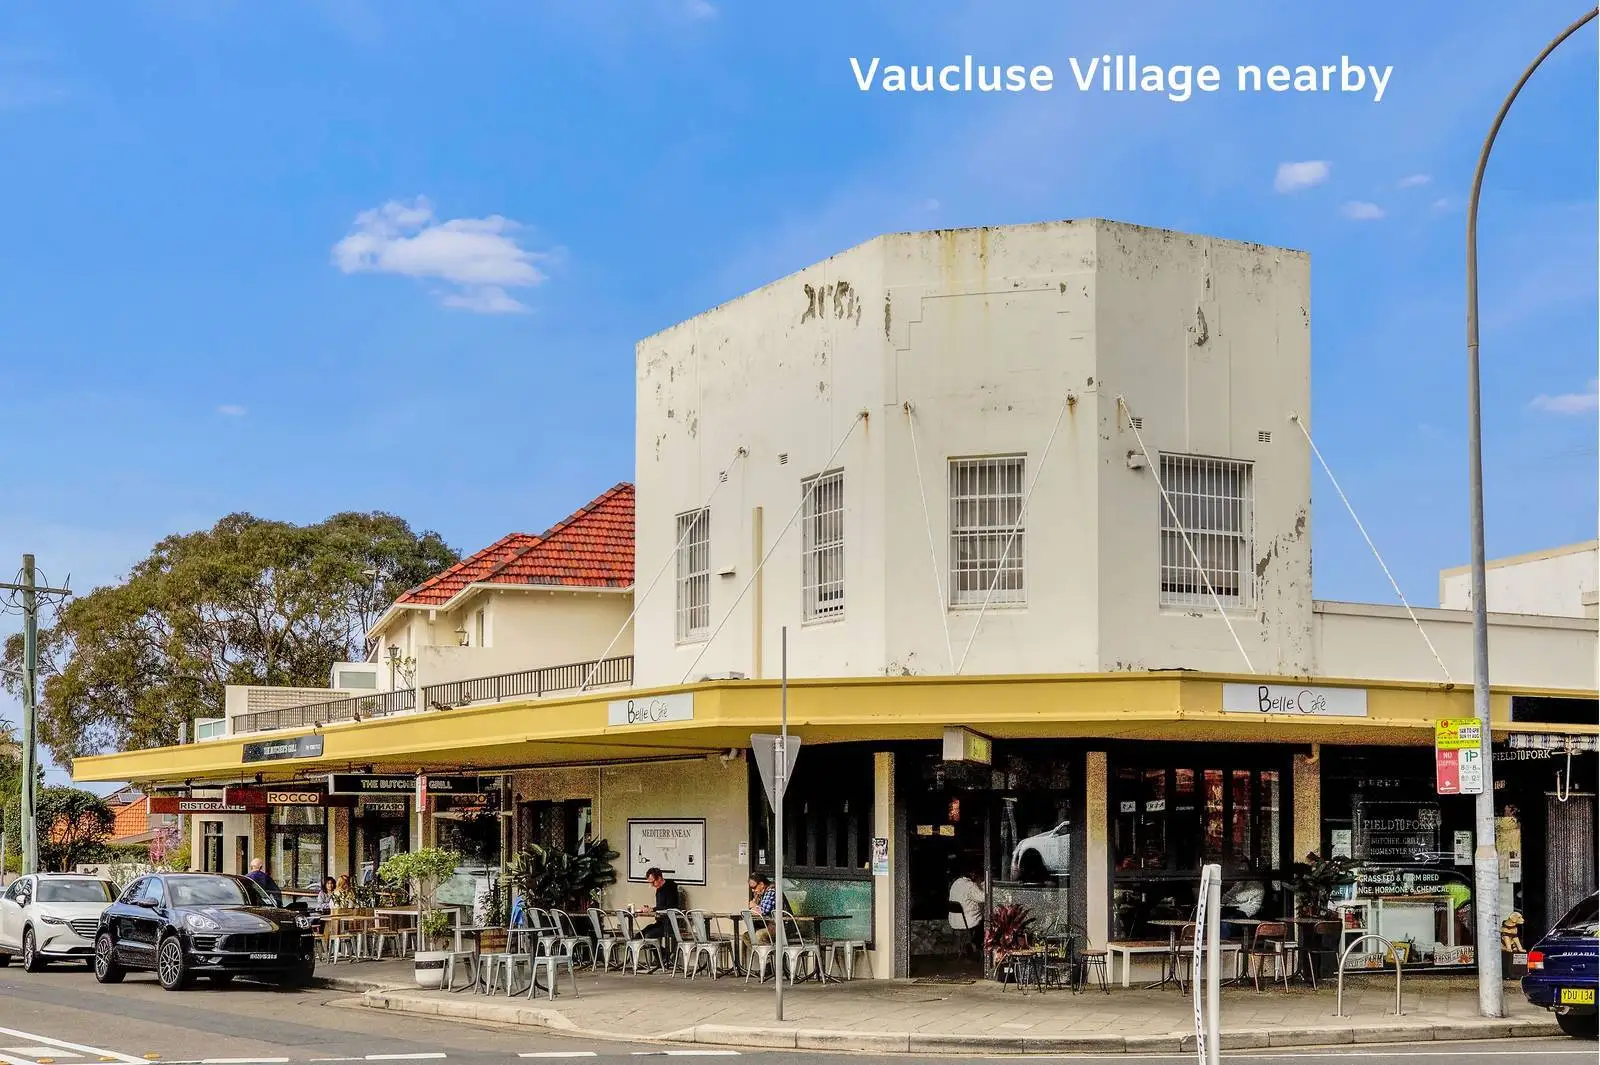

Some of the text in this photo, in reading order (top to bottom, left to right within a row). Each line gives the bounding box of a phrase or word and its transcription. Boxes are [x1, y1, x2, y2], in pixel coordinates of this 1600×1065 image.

[1258, 686, 1328, 714] Belle Café
[627, 699, 668, 724] Belle Café
[360, 779, 378, 789] THE
[428, 780, 453, 790] GRILL
[268, 793, 318, 803] ROCCO
[641, 828, 692, 838] MEDITERRANEAN
[1375, 885, 1409, 894] HORMONE
[1416, 884, 1449, 893] CHEMICAL
[1562, 990, 1593, 1000] YDU 134
